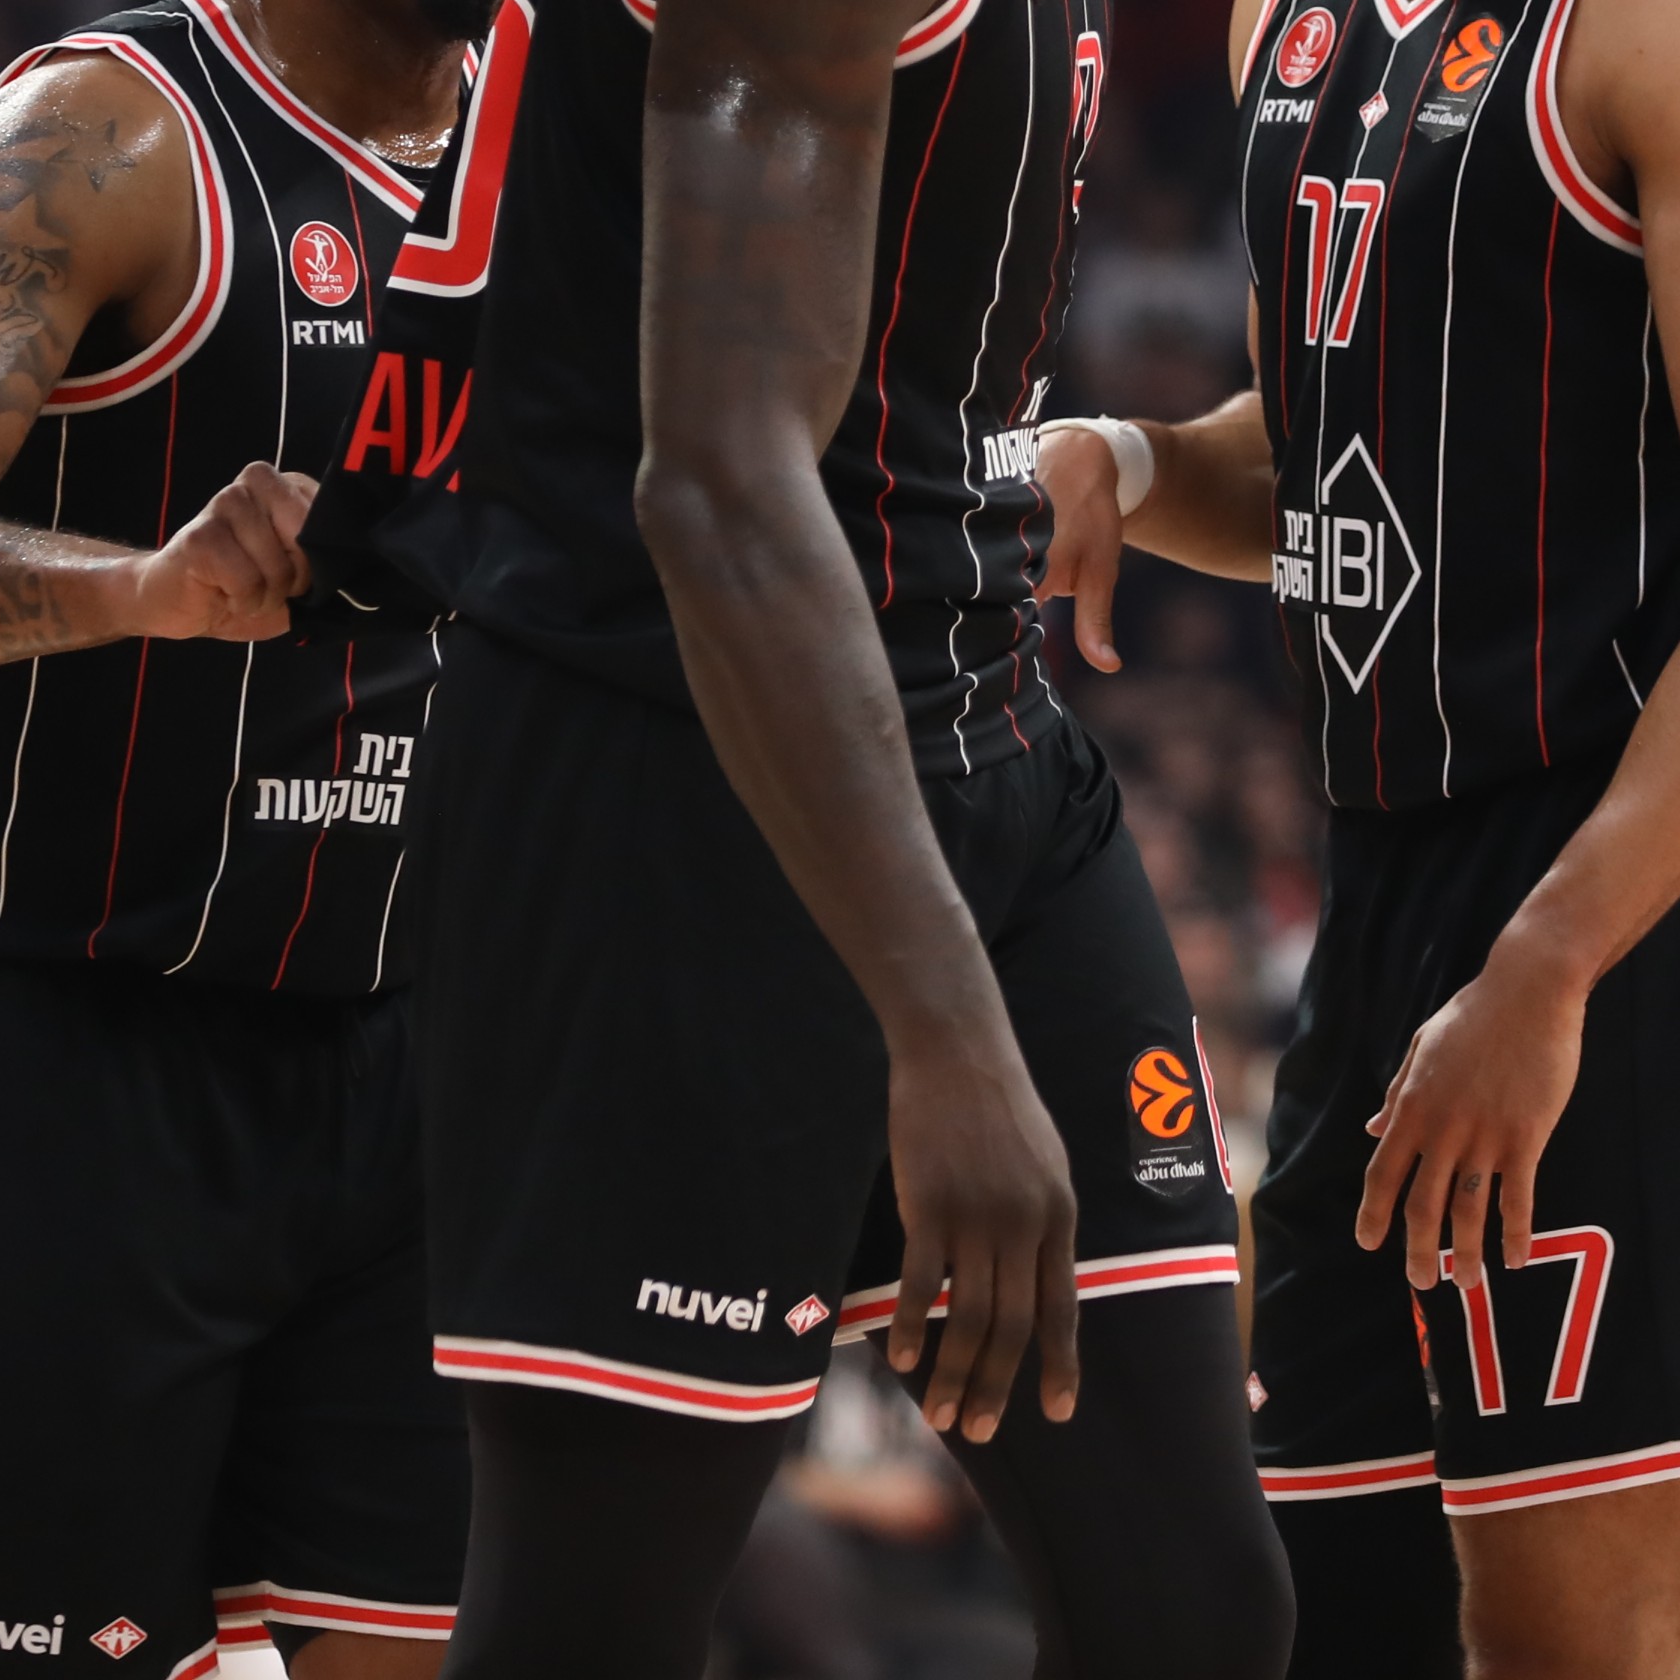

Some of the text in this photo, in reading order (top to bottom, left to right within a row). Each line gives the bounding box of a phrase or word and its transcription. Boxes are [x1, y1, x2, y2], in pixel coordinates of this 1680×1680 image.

[1259, 98, 1317, 124] RTMI
[1296, 174, 1386, 349] 17
[292, 320, 365, 345] RTMI
[343, 351, 479, 494] AV
[1284, 509, 1315, 555] בית
[1321, 514, 1386, 612] IBI
[353, 732, 415, 778] בית
[254, 778, 406, 829] השקעות
[1139, 1160, 1205, 1181] abu dhabi
[636, 1278, 769, 1333] nuvei
[1438, 1224, 1615, 1417] 17
